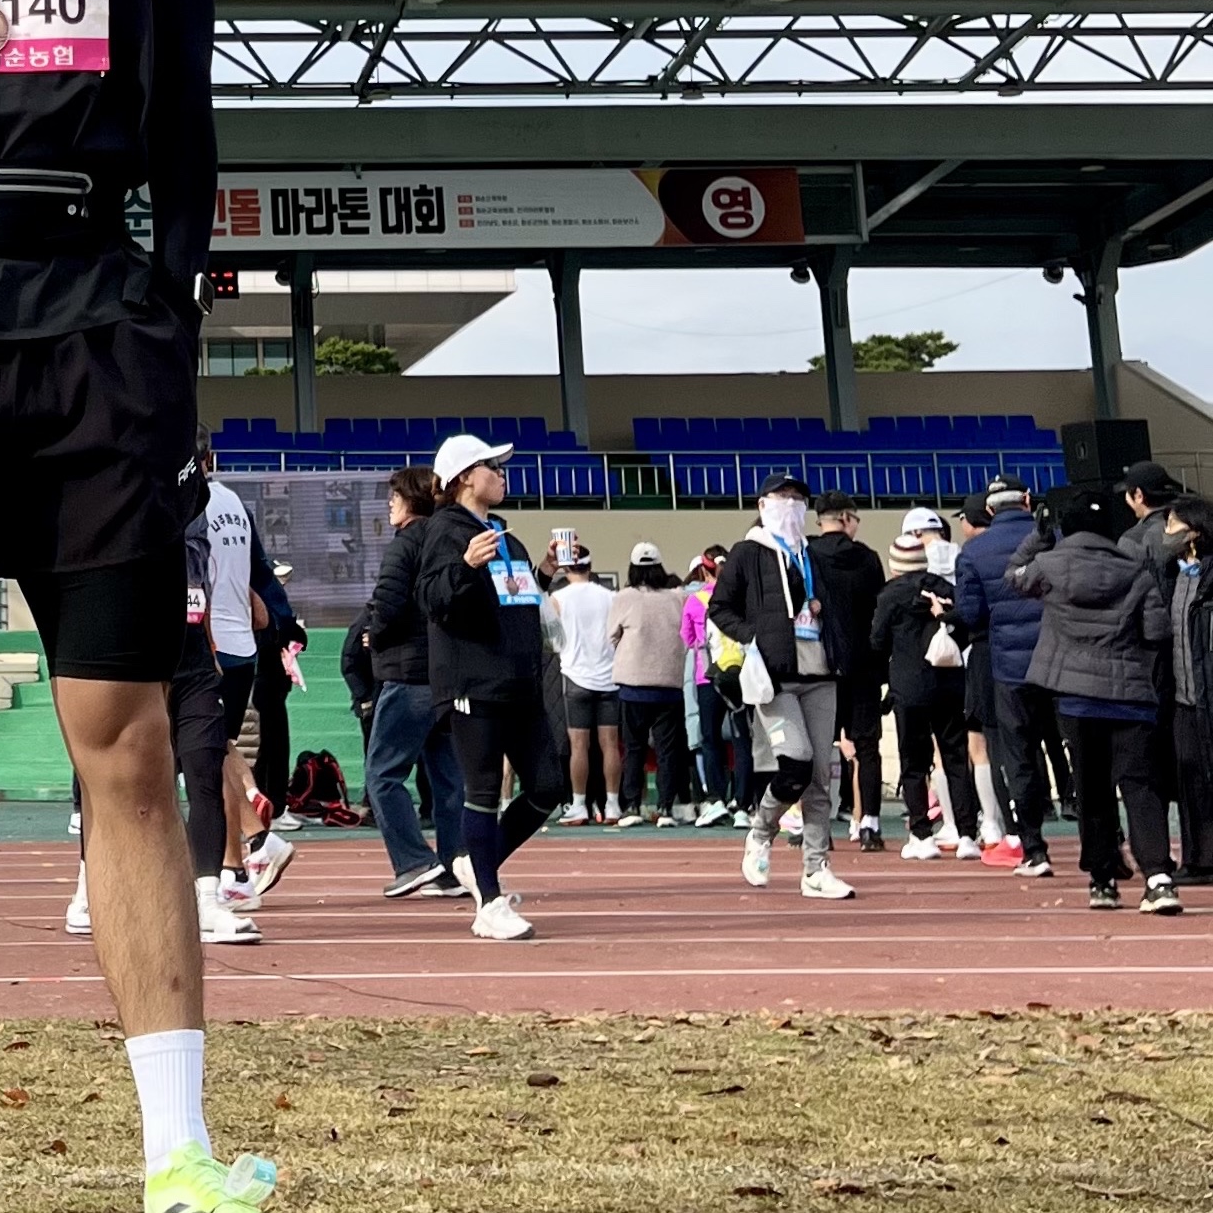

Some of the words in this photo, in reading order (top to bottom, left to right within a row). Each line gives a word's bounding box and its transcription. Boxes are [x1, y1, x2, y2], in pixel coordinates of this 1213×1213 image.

[124, 188, 152, 237] 순
[270, 187, 371, 236] 마라톤
[379, 184, 446, 235] 대회
[711, 186, 754, 230] 영
